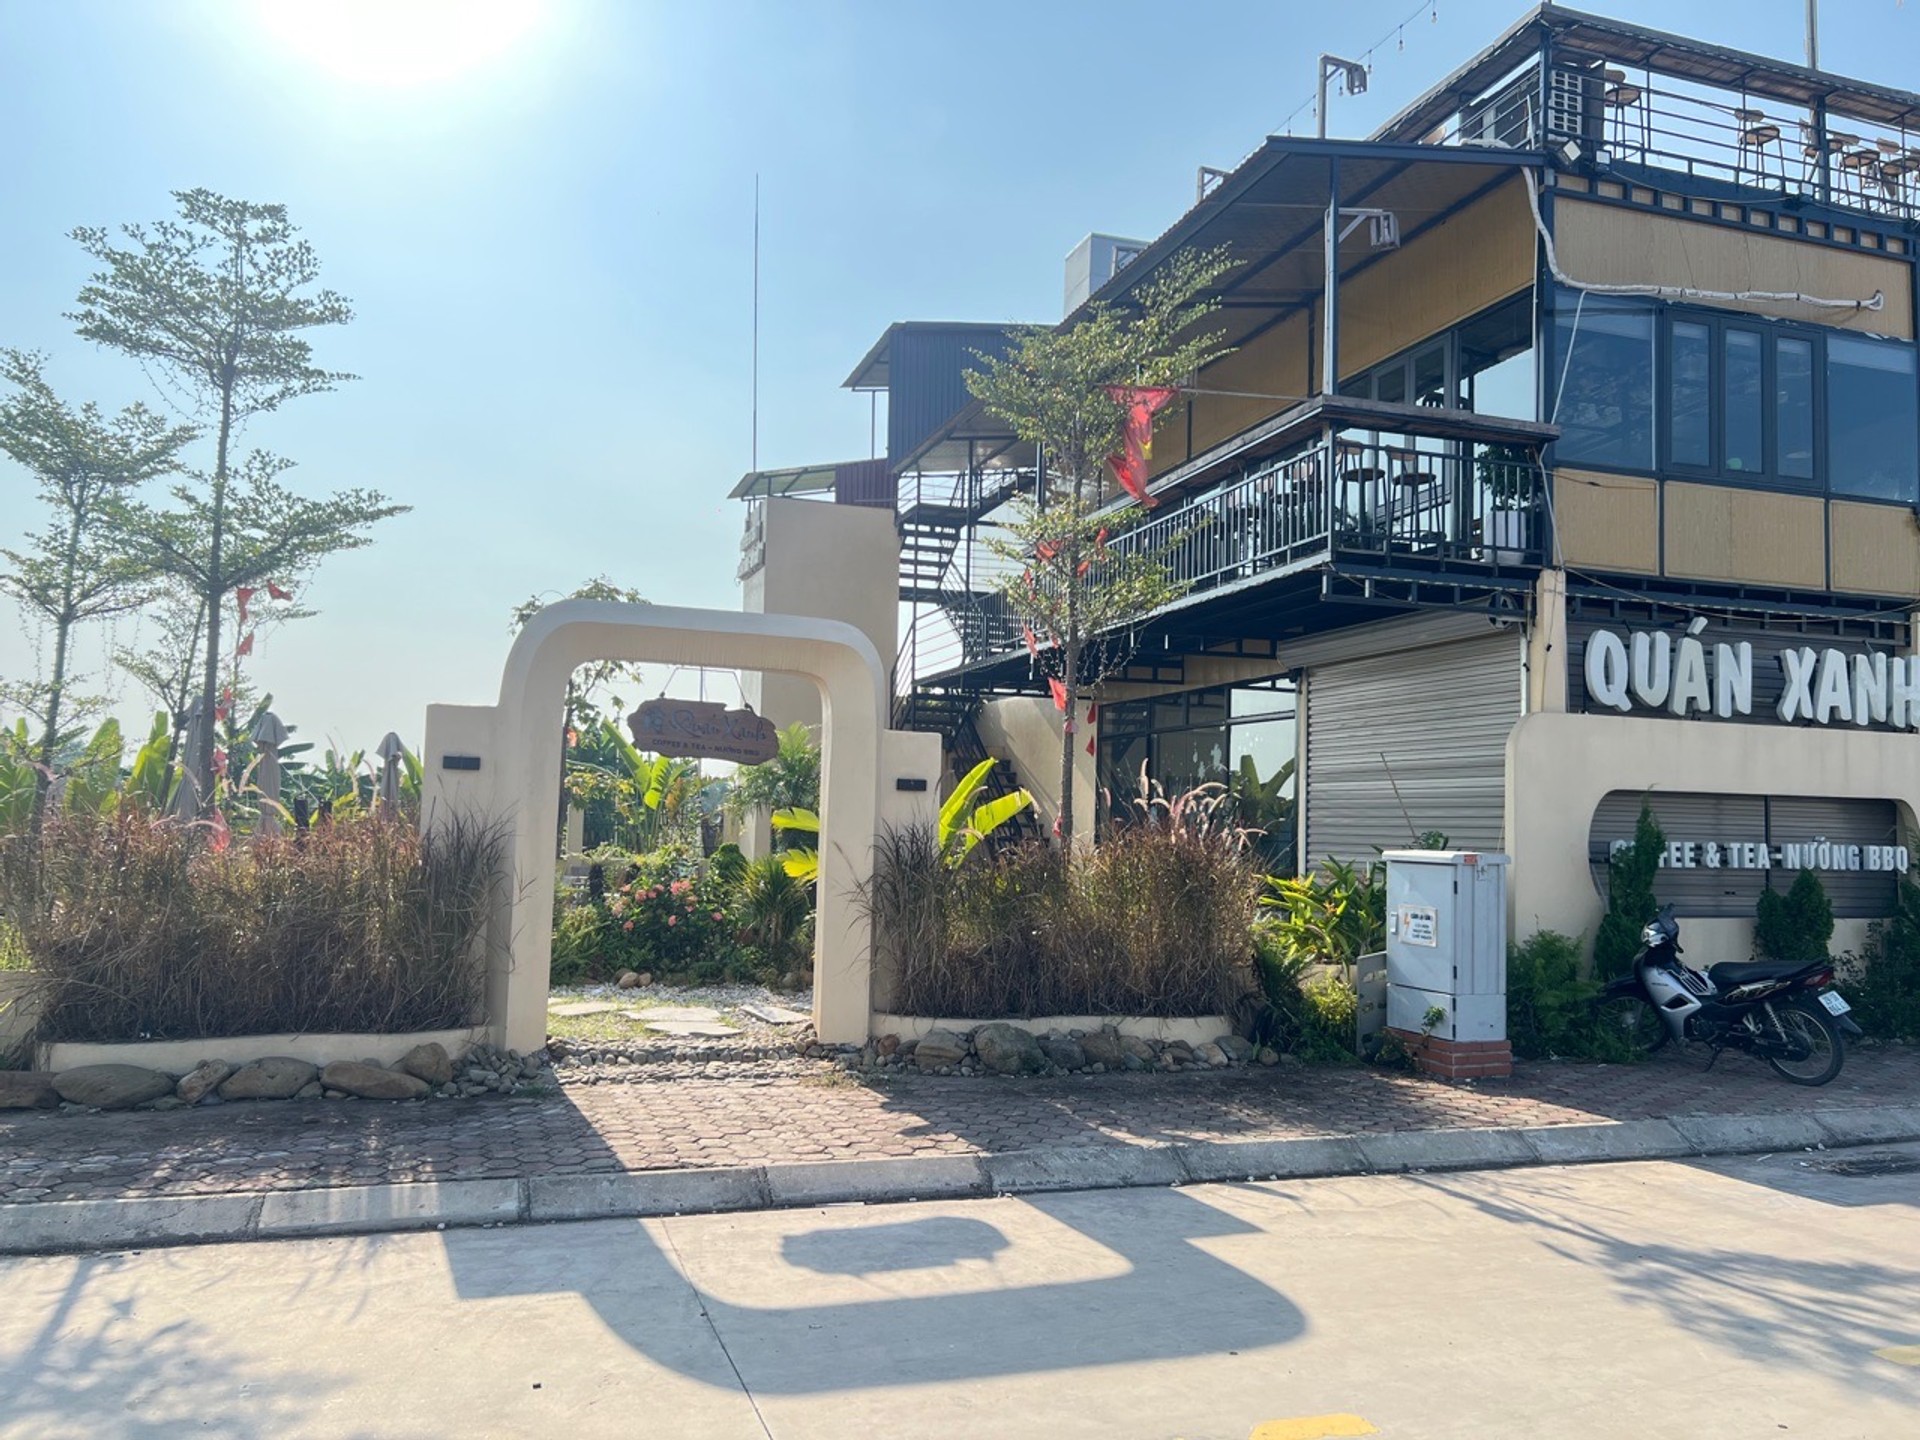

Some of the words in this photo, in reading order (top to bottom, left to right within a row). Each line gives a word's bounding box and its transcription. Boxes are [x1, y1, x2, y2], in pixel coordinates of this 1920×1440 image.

[1585, 617, 1752, 718] QUÁN
[1776, 646, 1920, 728] XANH
[652, 739, 681, 748] COFFEE
[692, 742, 706, 750] TEA
[1705, 841, 1721, 868] &
[1866, 845, 1908, 874] BBQ
